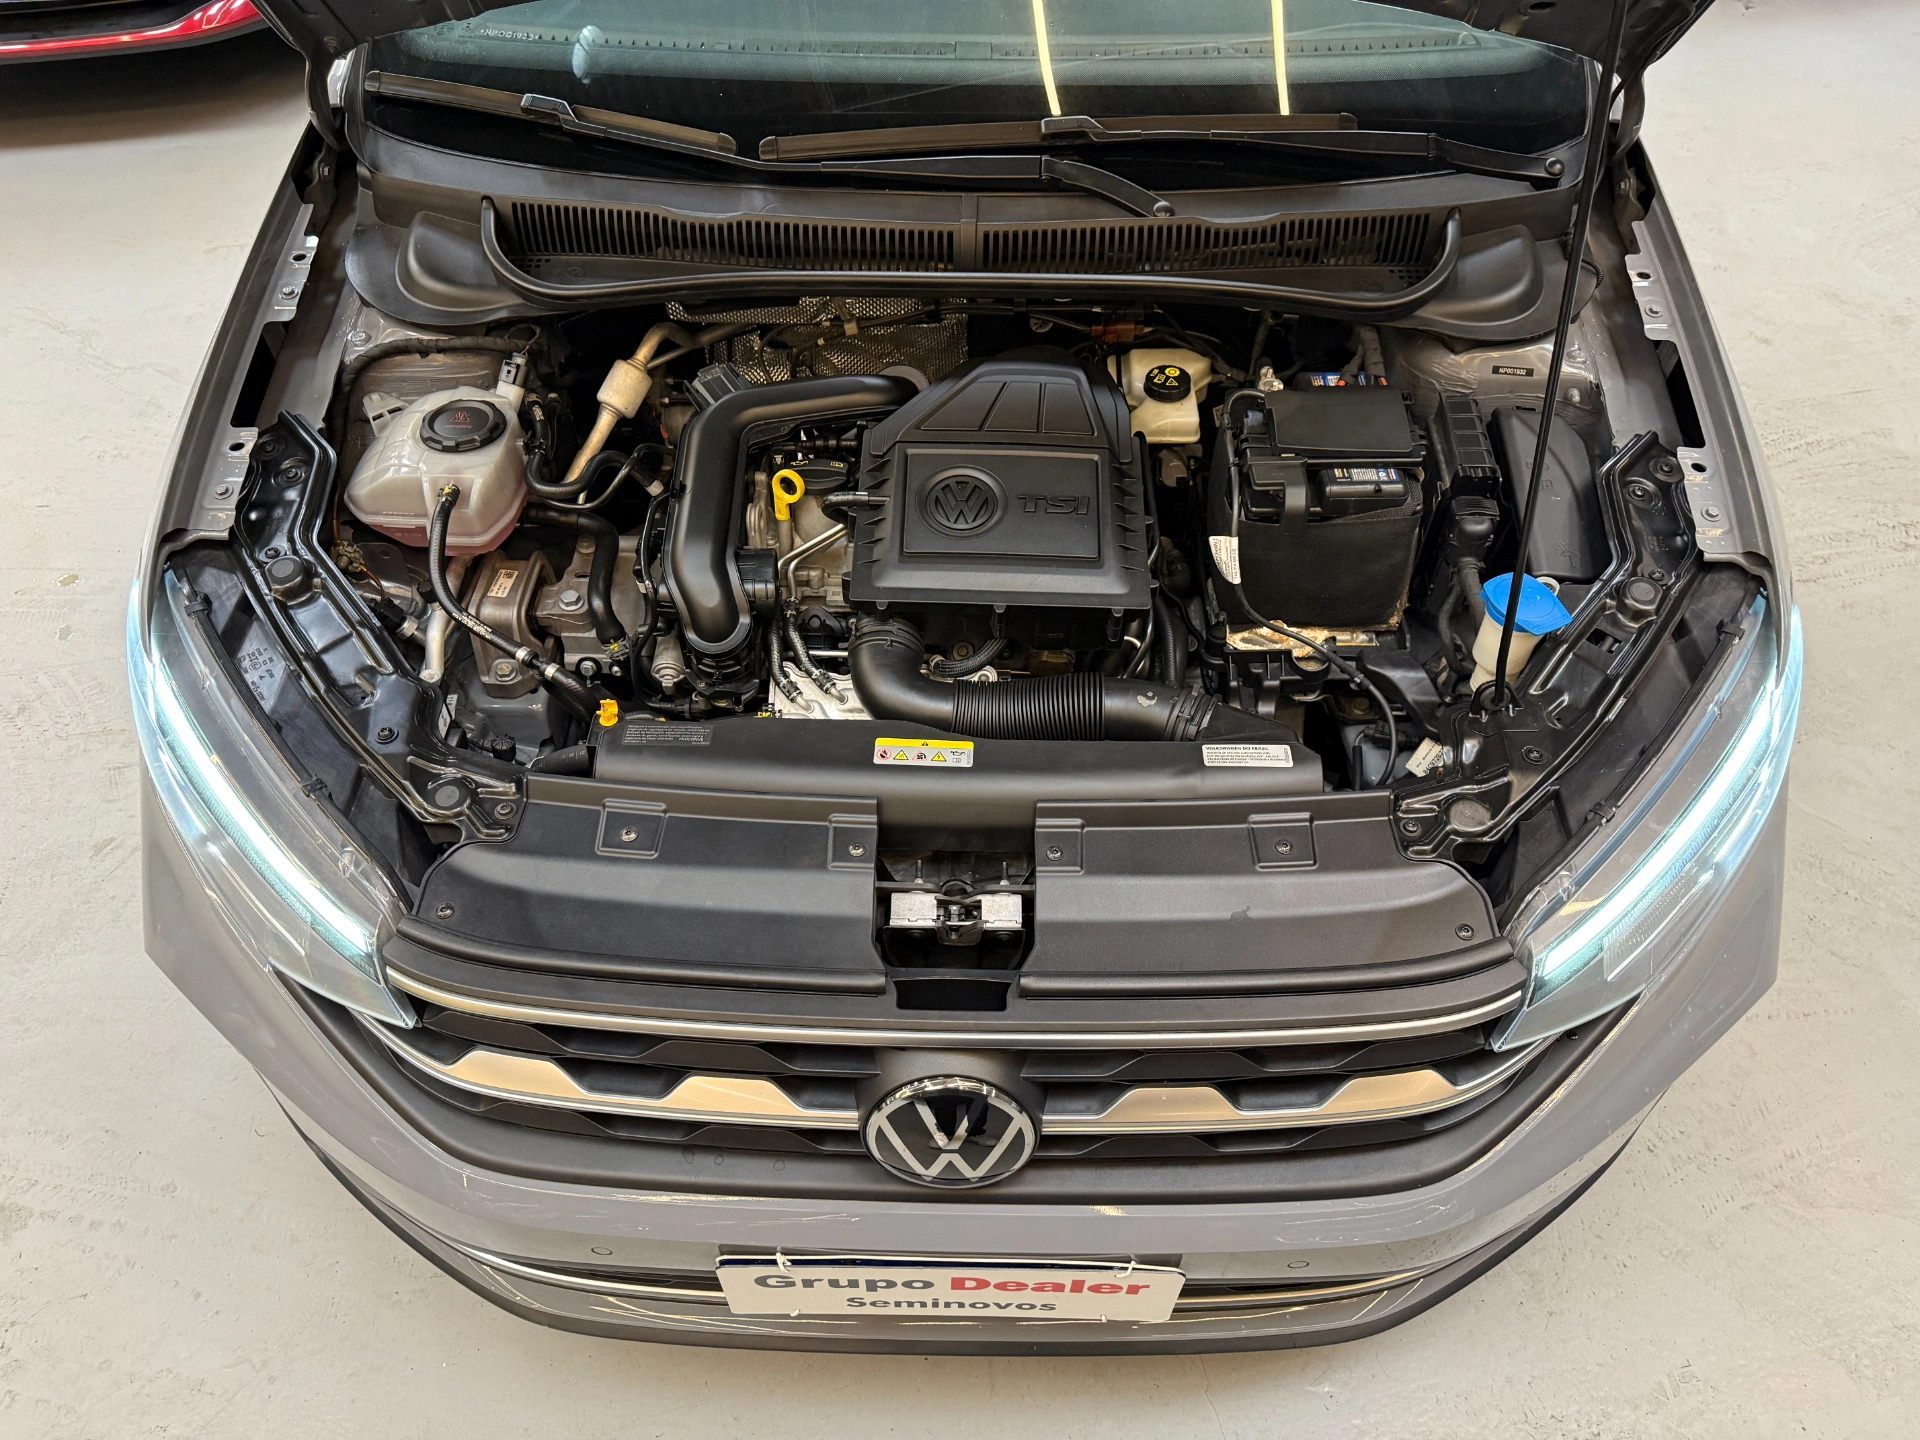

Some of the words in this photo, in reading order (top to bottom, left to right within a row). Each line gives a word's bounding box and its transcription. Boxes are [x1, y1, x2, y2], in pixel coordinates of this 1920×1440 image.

[1018, 493, 1091, 515] TSI
[753, 1274, 935, 1293] Grupo
[950, 1276, 1151, 1296] Dealer
[845, 1296, 1057, 1312] Seminovos
